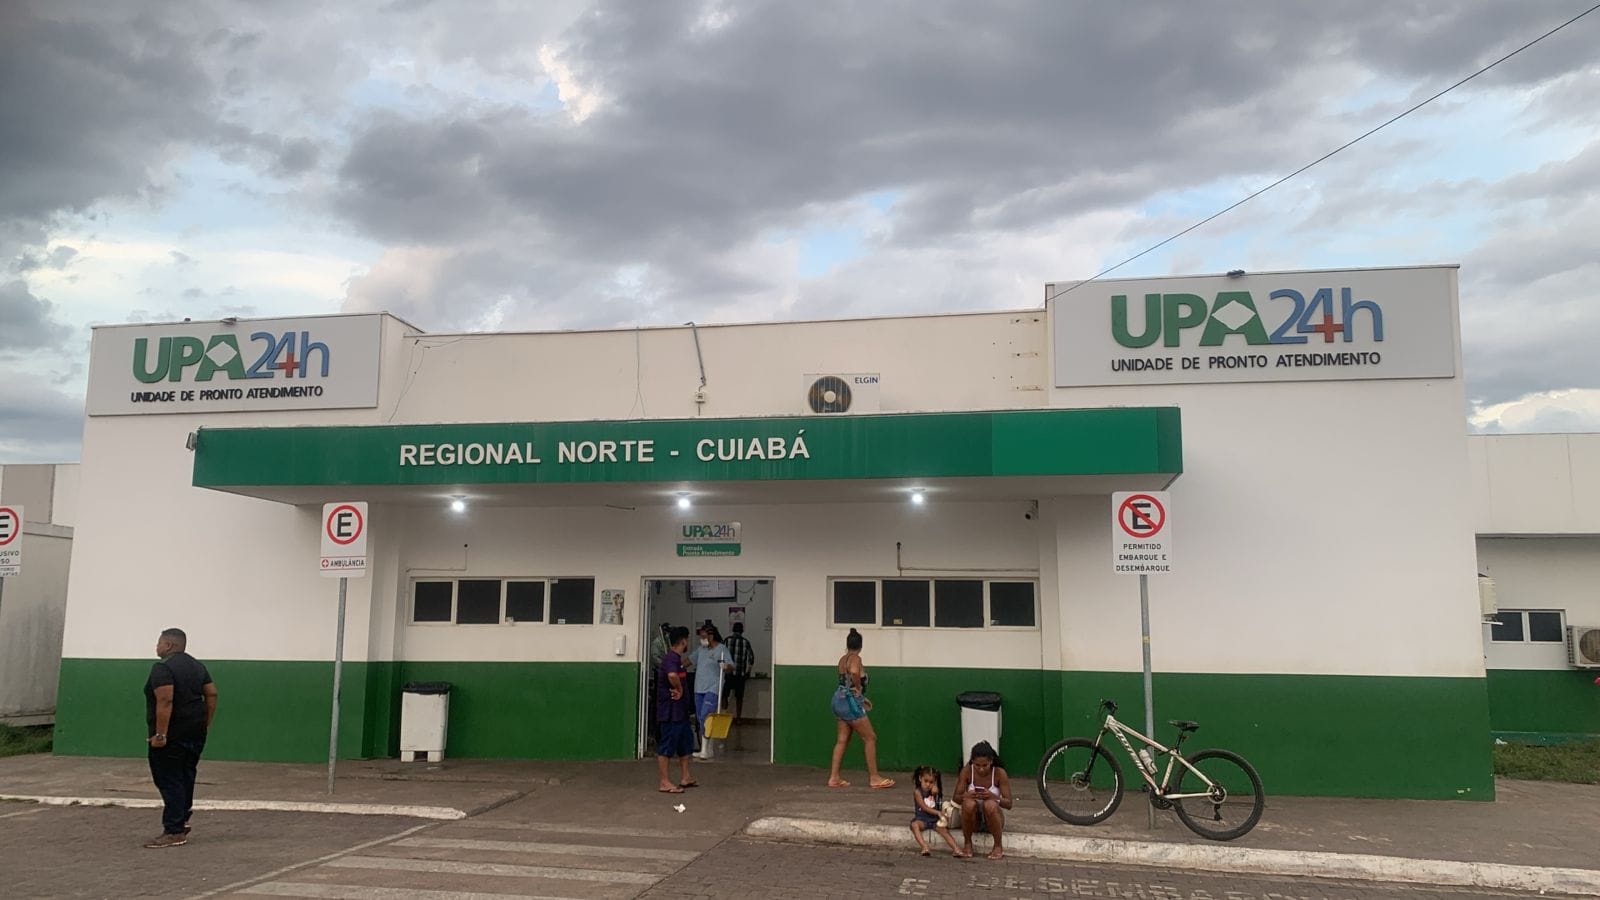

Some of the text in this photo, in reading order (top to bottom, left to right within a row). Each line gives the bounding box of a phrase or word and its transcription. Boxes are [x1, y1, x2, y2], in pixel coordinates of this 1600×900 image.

[1111, 352, 1381, 371] UNIDADE DE PRONTO ATENDIMENTO
[854, 376, 879, 385] ELGIN
[131, 386, 323, 402] UNIDADE DE PRONTO ATENDIMENTO
[400, 442, 540, 467] REGIONAL
[558, 440, 655, 464] NORTE
[696, 430, 811, 463] CUIABÁ
[337, 513, 352, 537] E
